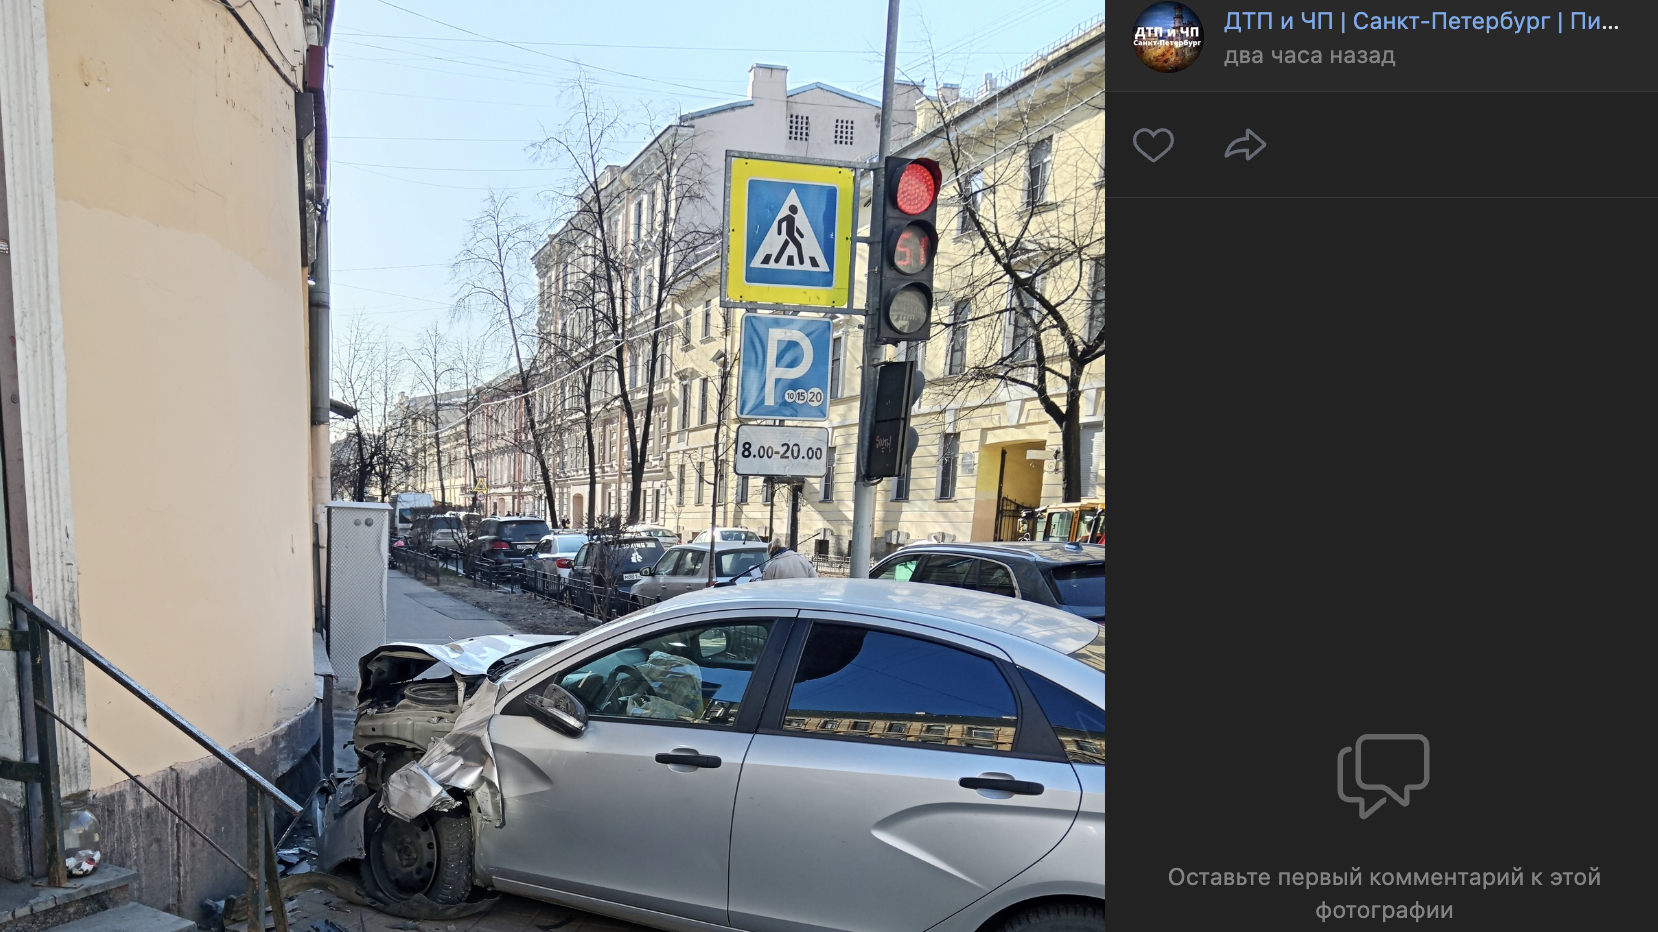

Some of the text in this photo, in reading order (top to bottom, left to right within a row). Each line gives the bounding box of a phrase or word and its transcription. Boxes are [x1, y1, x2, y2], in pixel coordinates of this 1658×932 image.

[786, 391, 822, 403] 10 15 20
[741, 441, 823, 460] 8.00-20.00
